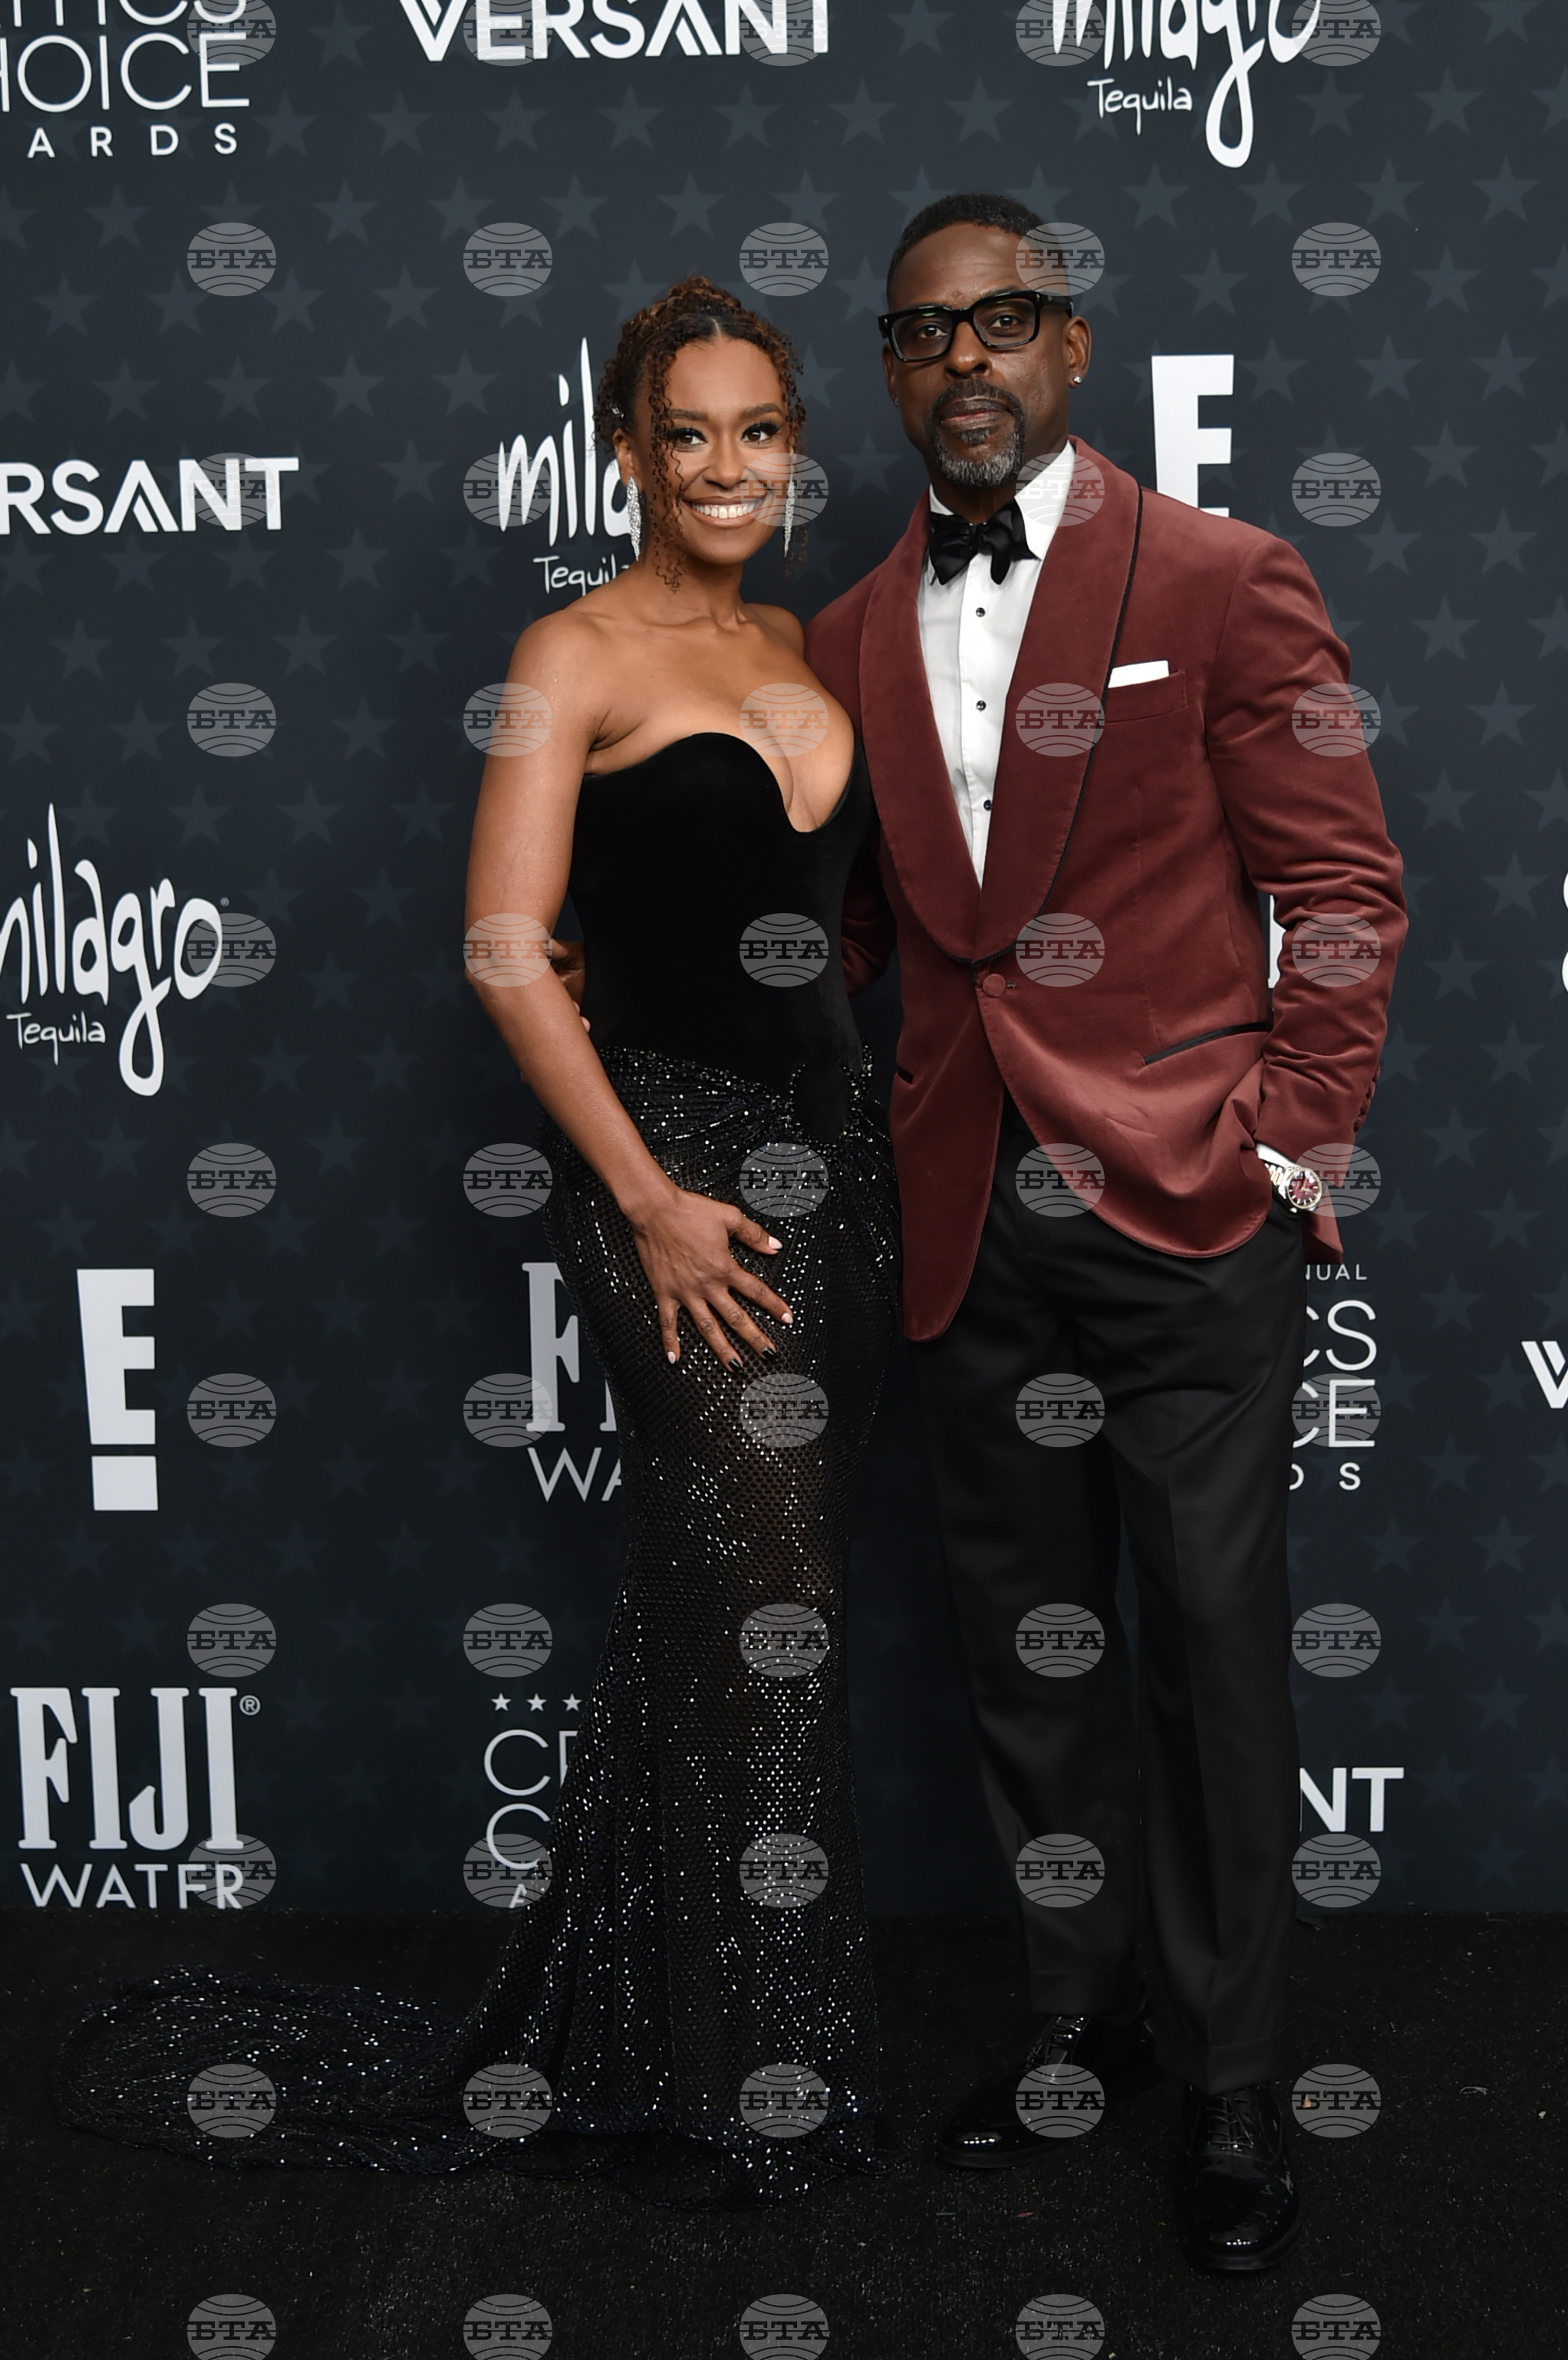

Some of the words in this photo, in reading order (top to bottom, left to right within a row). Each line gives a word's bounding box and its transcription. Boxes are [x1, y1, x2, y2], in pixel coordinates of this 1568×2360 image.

[0, 32, 250, 112] OICE
[1086, 76, 1193, 137] Tequila
[6, 1010, 106, 1066] Tequila
